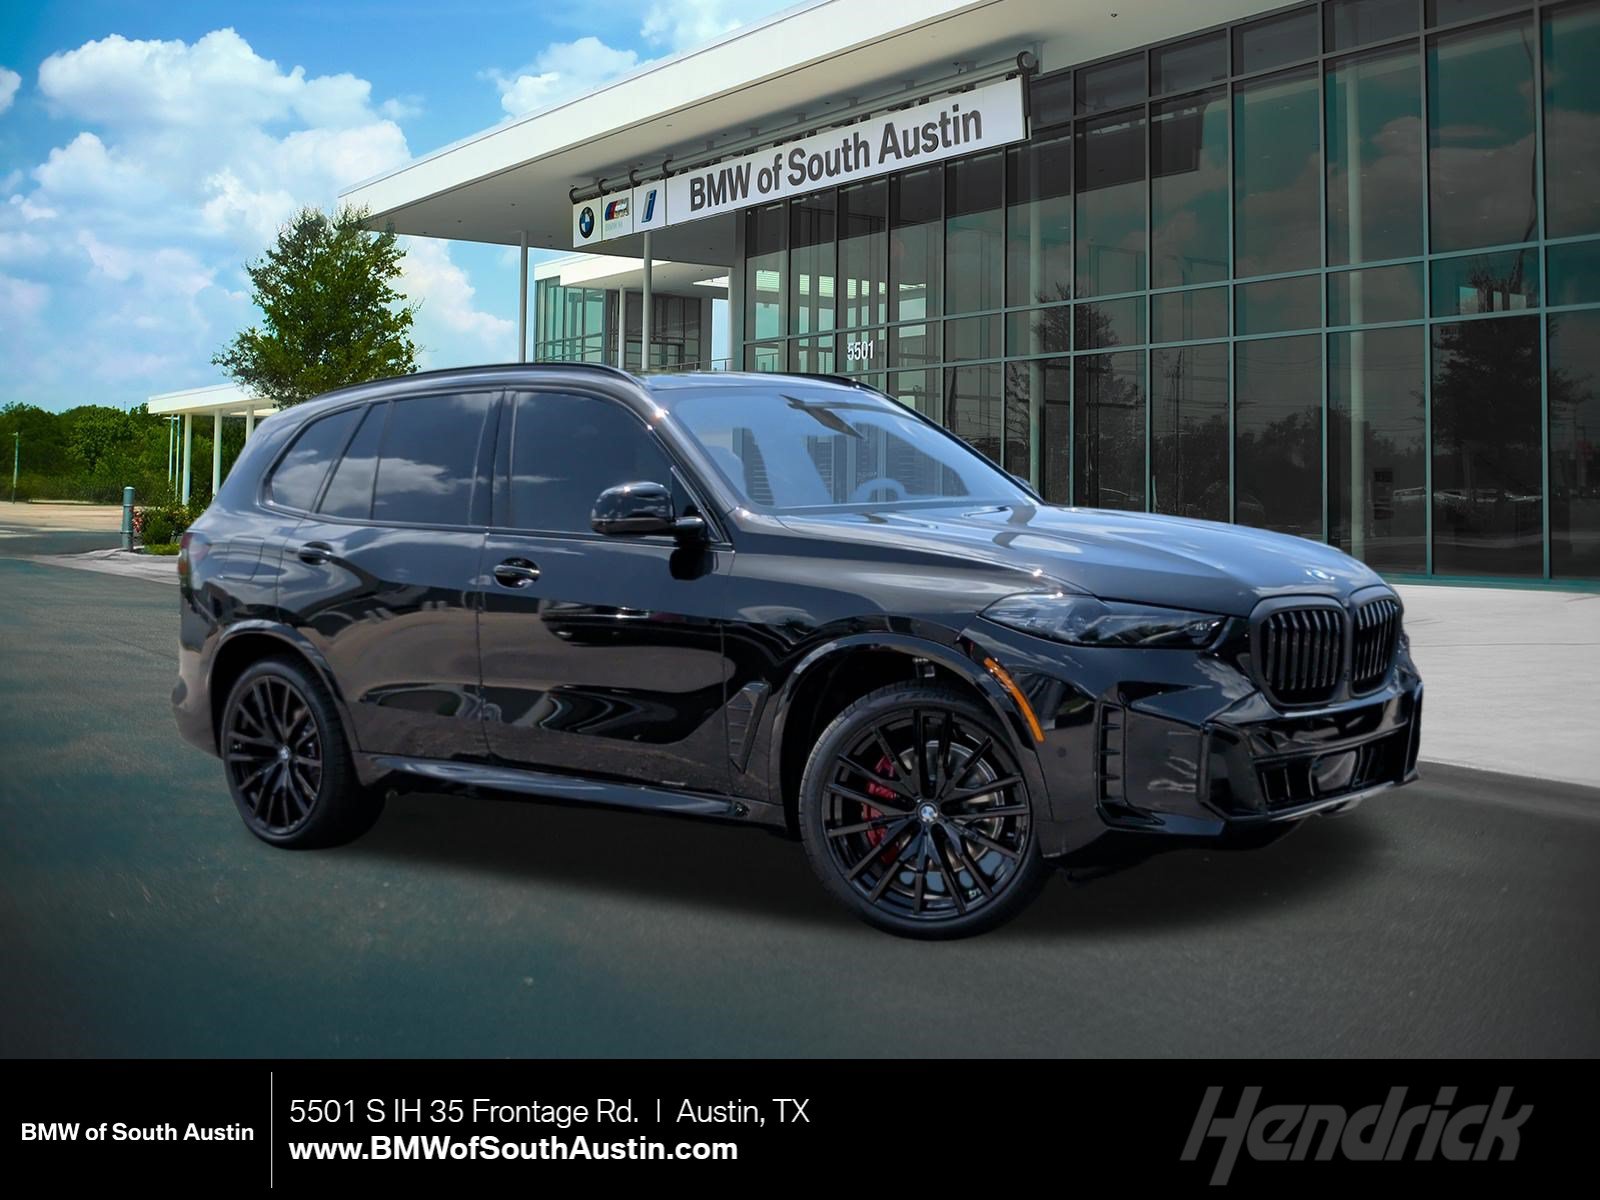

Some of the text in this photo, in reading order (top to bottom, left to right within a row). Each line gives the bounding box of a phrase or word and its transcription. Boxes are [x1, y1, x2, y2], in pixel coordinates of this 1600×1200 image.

[690, 104, 982, 211] BMW of South Austin
[847, 340, 874, 360] 5501
